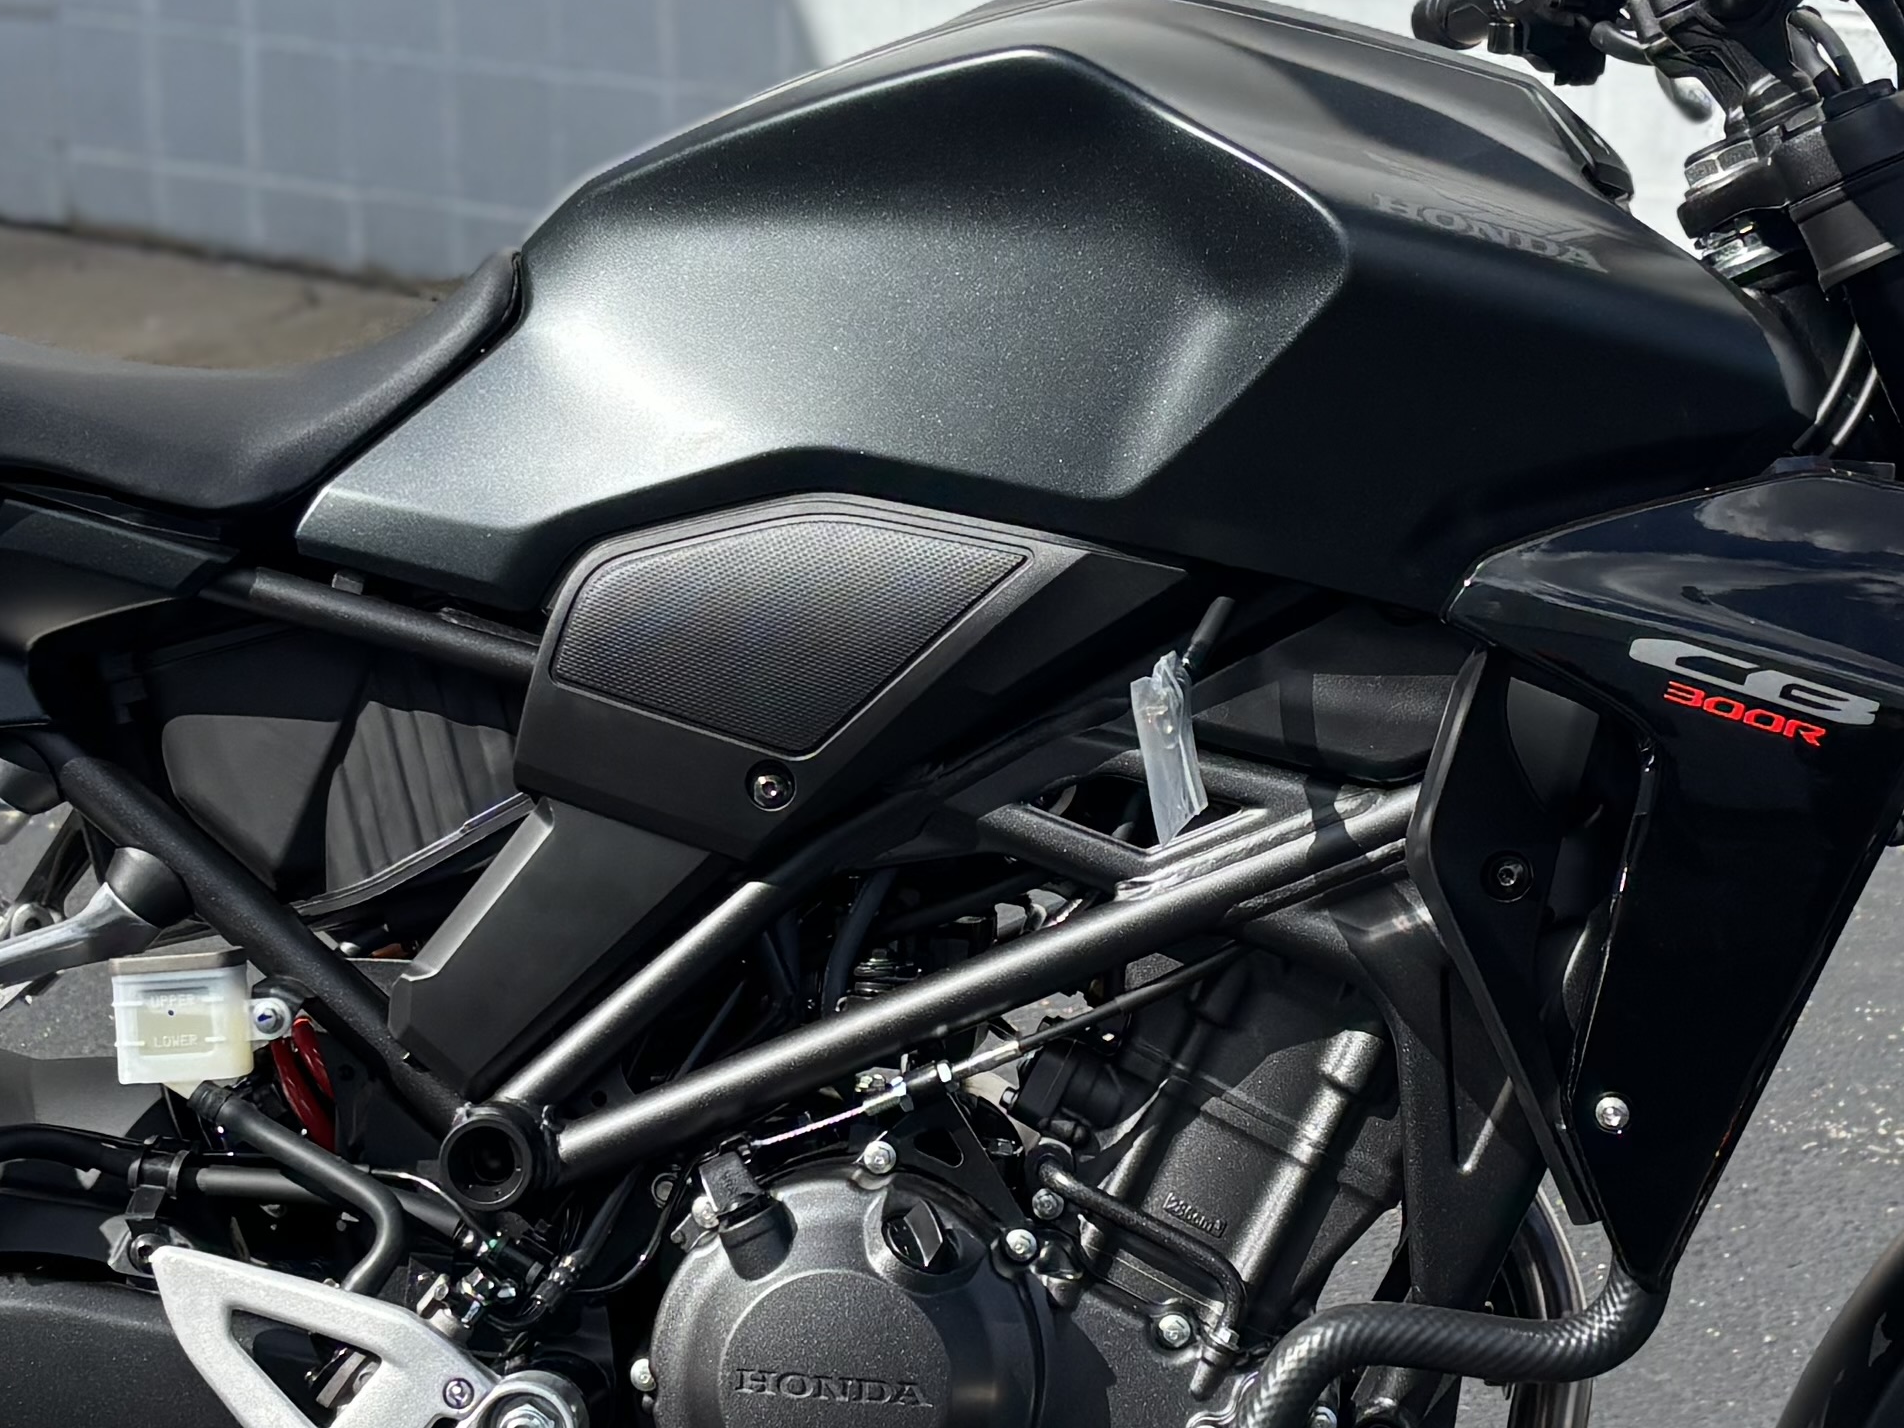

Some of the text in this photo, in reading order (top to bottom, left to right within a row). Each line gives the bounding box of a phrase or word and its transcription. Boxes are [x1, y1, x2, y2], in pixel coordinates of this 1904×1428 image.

[1368, 191, 1609, 274] HONDA
[1628, 637, 1881, 726] CB
[1663, 680, 1827, 747] 300R
[149, 993, 197, 1009] UPPER
[153, 1033, 198, 1049] LOWER
[733, 1367, 935, 1409] HONDA
